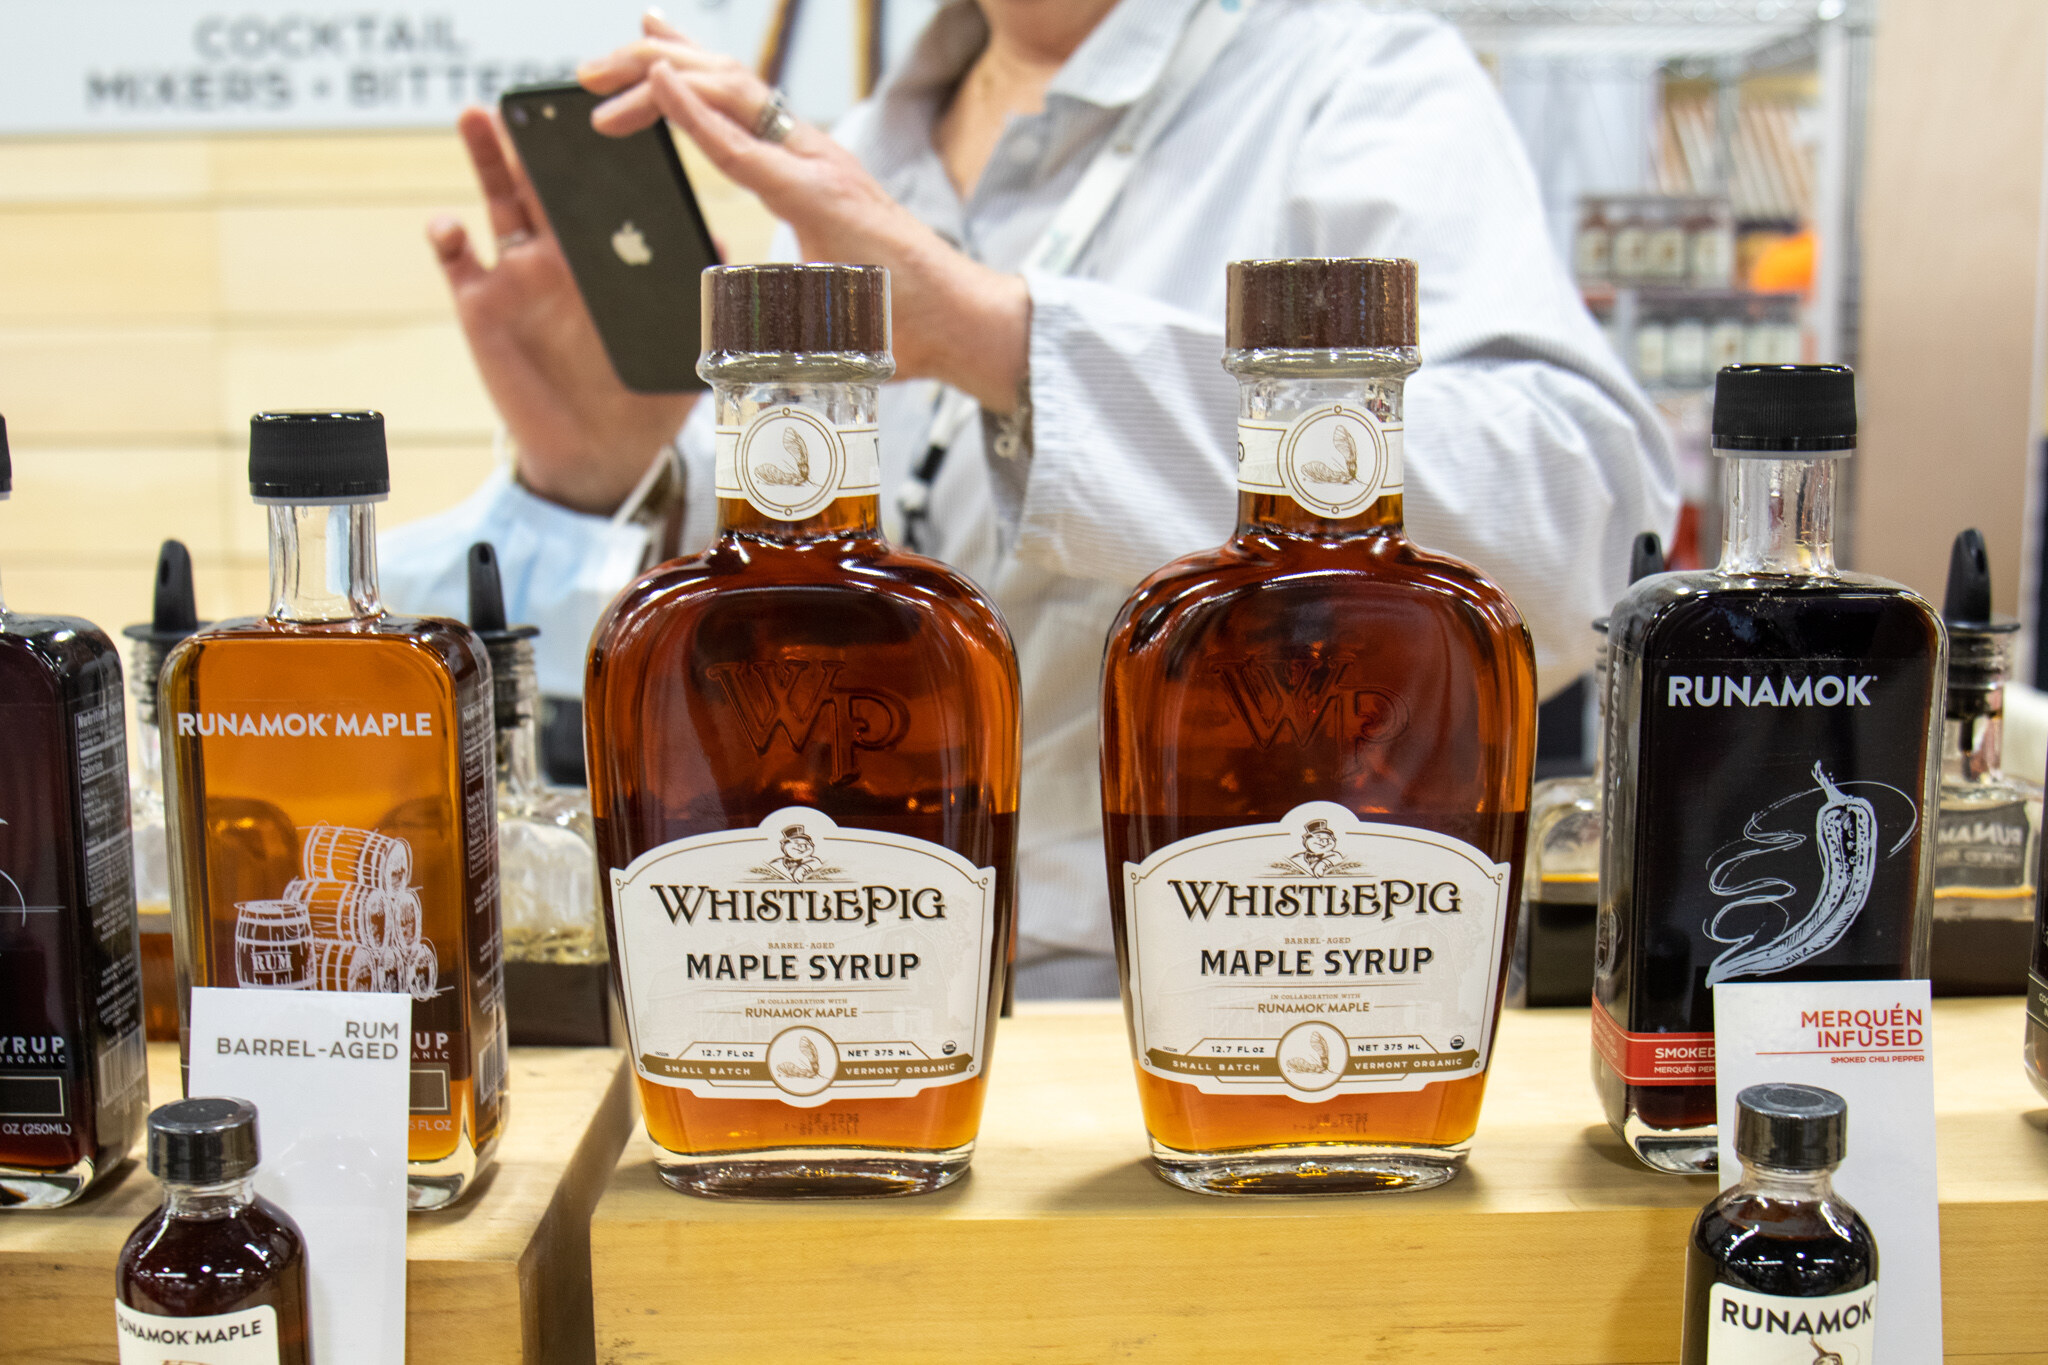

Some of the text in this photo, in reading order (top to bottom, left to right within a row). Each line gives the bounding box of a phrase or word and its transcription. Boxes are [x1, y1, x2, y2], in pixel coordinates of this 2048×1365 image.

[196, 14, 470, 60] COCKTAIL
[86, 68, 292, 110] MIXERS
[335, 712, 433, 737] MAPLE
[252, 954, 293, 971] RUM
[686, 953, 920, 981] MAPLE SYRUP
[1201, 946, 1434, 977] MAPLE SYRUP
[745, 1007, 858, 1018] RUNAMOK MAPLE
[1258, 1001, 1370, 1013] RUNAMOK MAPLE
[1801, 1002, 1923, 1030] MERQUÉN
[345, 1021, 399, 1040] RUM
[1817, 1029, 1923, 1048] INFUSED
[216, 1037, 399, 1060] BARREL-AGED
[727, 1050, 740, 1058] FL
[847, 1049, 869, 1057] NET
[1357, 1044, 1379, 1052] NET
[1655, 1047, 1715, 1059] SMOKED
[0, 1055, 66, 1064] RGANIC
[1354, 1058, 1462, 1070] VERMONT ORGANIC
[1830, 1056, 1867, 1064] SMOKED
[1892, 1055, 1925, 1063] PEPPER
[664, 1064, 751, 1076] SMALL BATCH
[845, 1063, 956, 1075] VERMONT ORGANIC
[1172, 1060, 1260, 1072] SMALL BATCH
[1654, 1064, 1696, 1074] MERQUÉN
[2, 1122, 72, 1136] OZ (250ML)
[418, 1121, 432, 1131] FL
[434, 1120, 452, 1131] OZ
[1721, 1294, 1874, 1335] RUNAMOK
[195, 1319, 262, 1345] MAPLE
